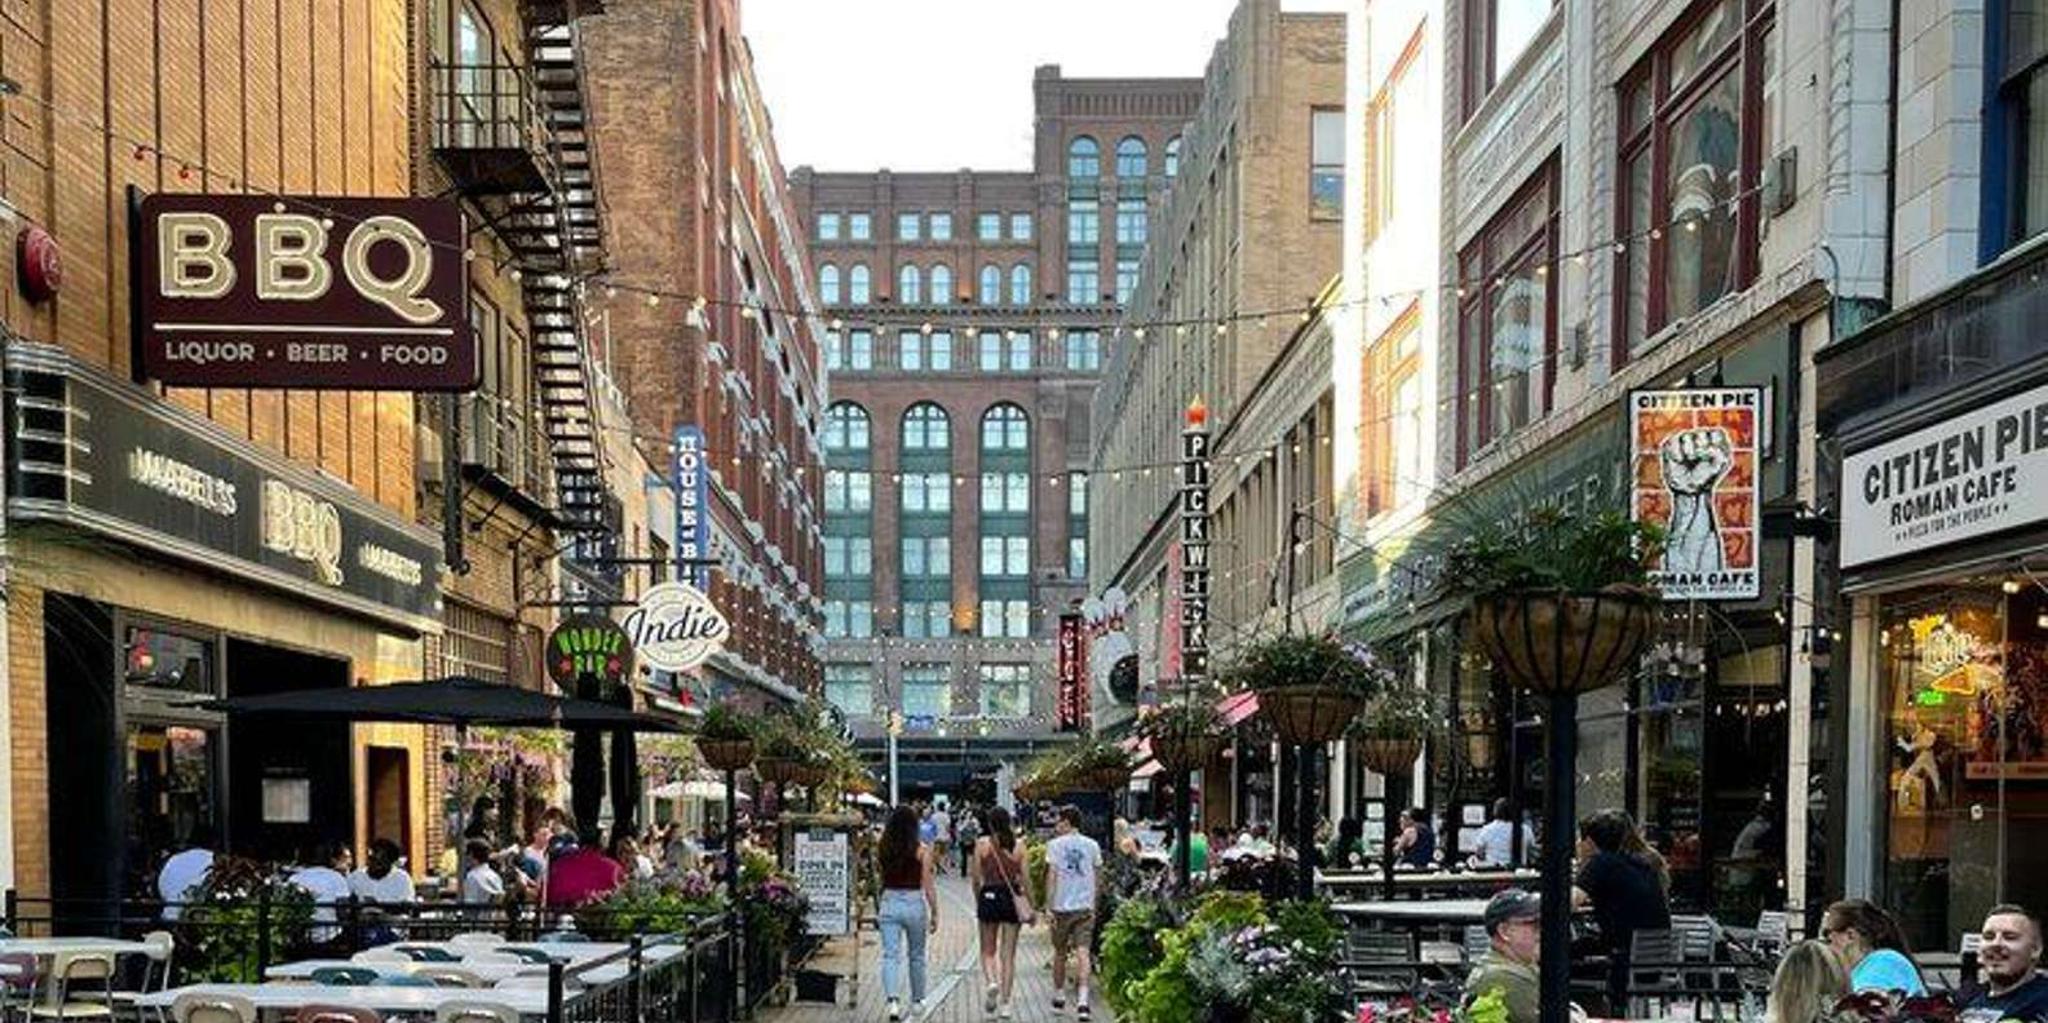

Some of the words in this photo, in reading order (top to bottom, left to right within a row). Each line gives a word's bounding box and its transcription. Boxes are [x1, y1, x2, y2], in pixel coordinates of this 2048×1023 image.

[158, 212, 444, 324] BBQ
[166, 341, 254, 364] LIQUOR
[287, 343, 347, 363] BEER
[381, 345, 447, 365] FOOD
[1638, 393, 1716, 408] CITIZEN
[1722, 392, 1755, 407] PIE
[679, 436, 699, 526] HOUSE
[1864, 429, 1984, 505] CITIZEN
[1996, 402, 2048, 463] PIE
[262, 479, 343, 586] BBQ
[1891, 483, 1958, 526] ROMAN
[1963, 466, 2017, 505] CAFE
[1188, 436, 1205, 648] PICKWICK
[1650, 572, 1702, 587] OMAN
[1708, 572, 1754, 586] CAFE
[624, 604, 724, 648] Indie
